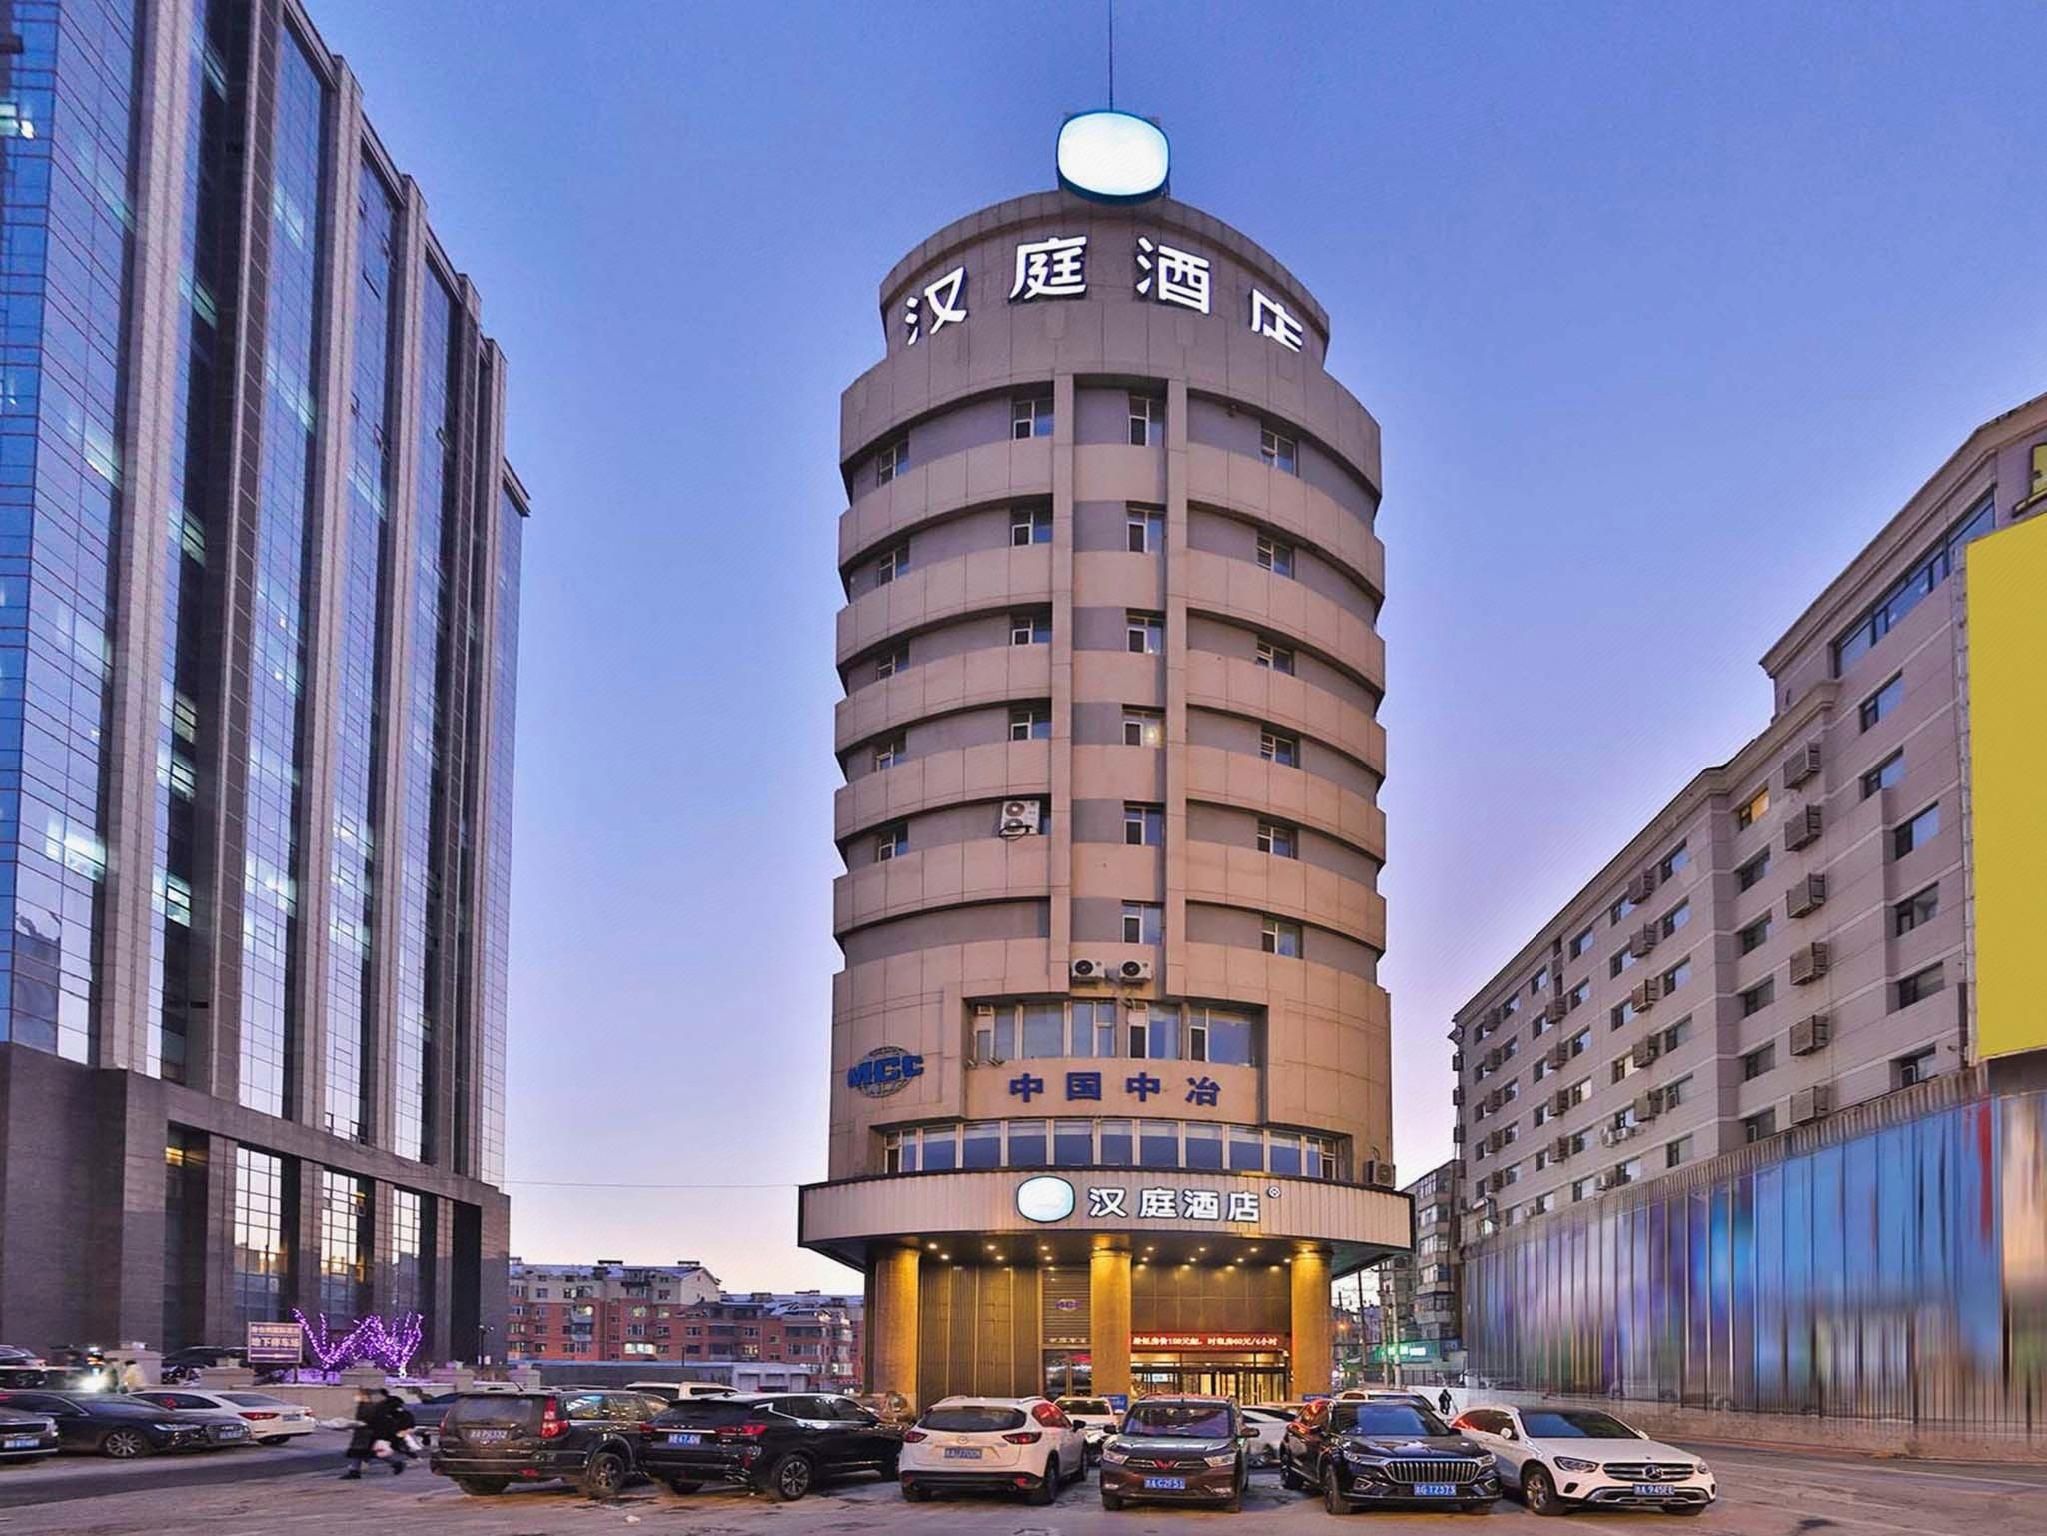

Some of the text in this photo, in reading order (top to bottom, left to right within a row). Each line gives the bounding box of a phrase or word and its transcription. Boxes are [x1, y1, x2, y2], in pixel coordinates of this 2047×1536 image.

[847, 1055, 924, 1088] MCC
[1009, 1071, 1221, 1107] 中国中冶
[1088, 1186, 1261, 1222] 汉庭酒店
